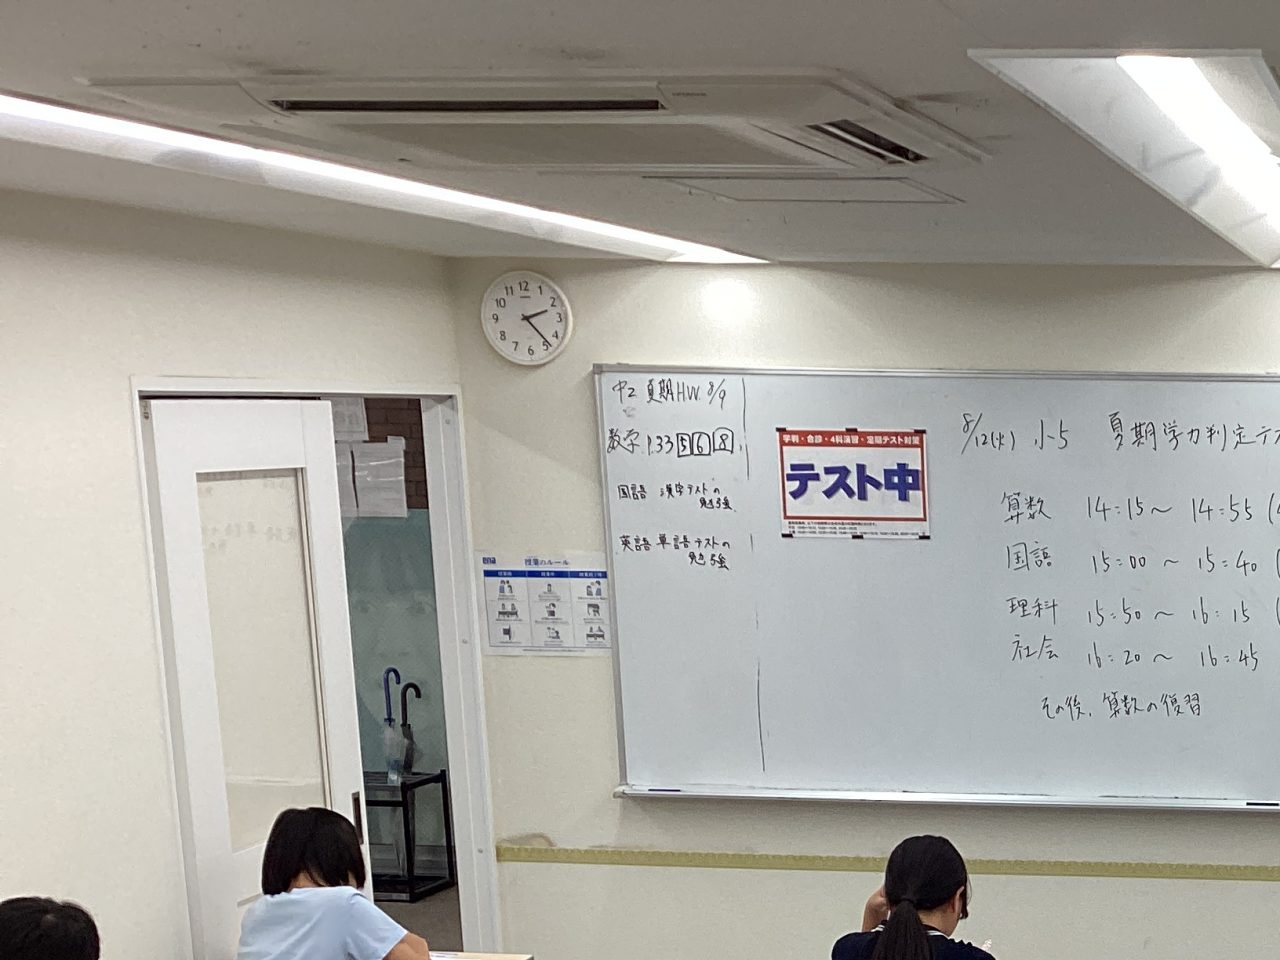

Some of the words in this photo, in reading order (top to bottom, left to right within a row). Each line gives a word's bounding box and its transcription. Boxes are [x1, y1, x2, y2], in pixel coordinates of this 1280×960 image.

[505, 286, 514, 296] 11
[519, 281, 529, 291] 12
[495, 298, 506, 308] 10
[550, 297, 556, 307] 2
[492, 314, 498, 323] 9
[556, 313, 562, 323] 3
[500, 331, 506, 341] 8
[552, 331, 558, 340] 4
[512, 341, 518, 351] 7
[528, 346, 534, 355] 6
[542, 341, 548, 351] 5
[1034, 420, 1069, 449] 小5
[607, 428, 640, 454] 数学
[786, 462, 922, 502] テスト中
[618, 484, 647, 500] 国語
[660, 482, 720, 499] 漢字テストの
[1001, 492, 1052, 523] 算数
[620, 534, 651, 551] 英語
[657, 533, 731, 550] 単語テストの
[1007, 541, 1052, 572] 国語
[1007, 597, 1058, 625] 理科
[1012, 633, 1059, 662] 社会
